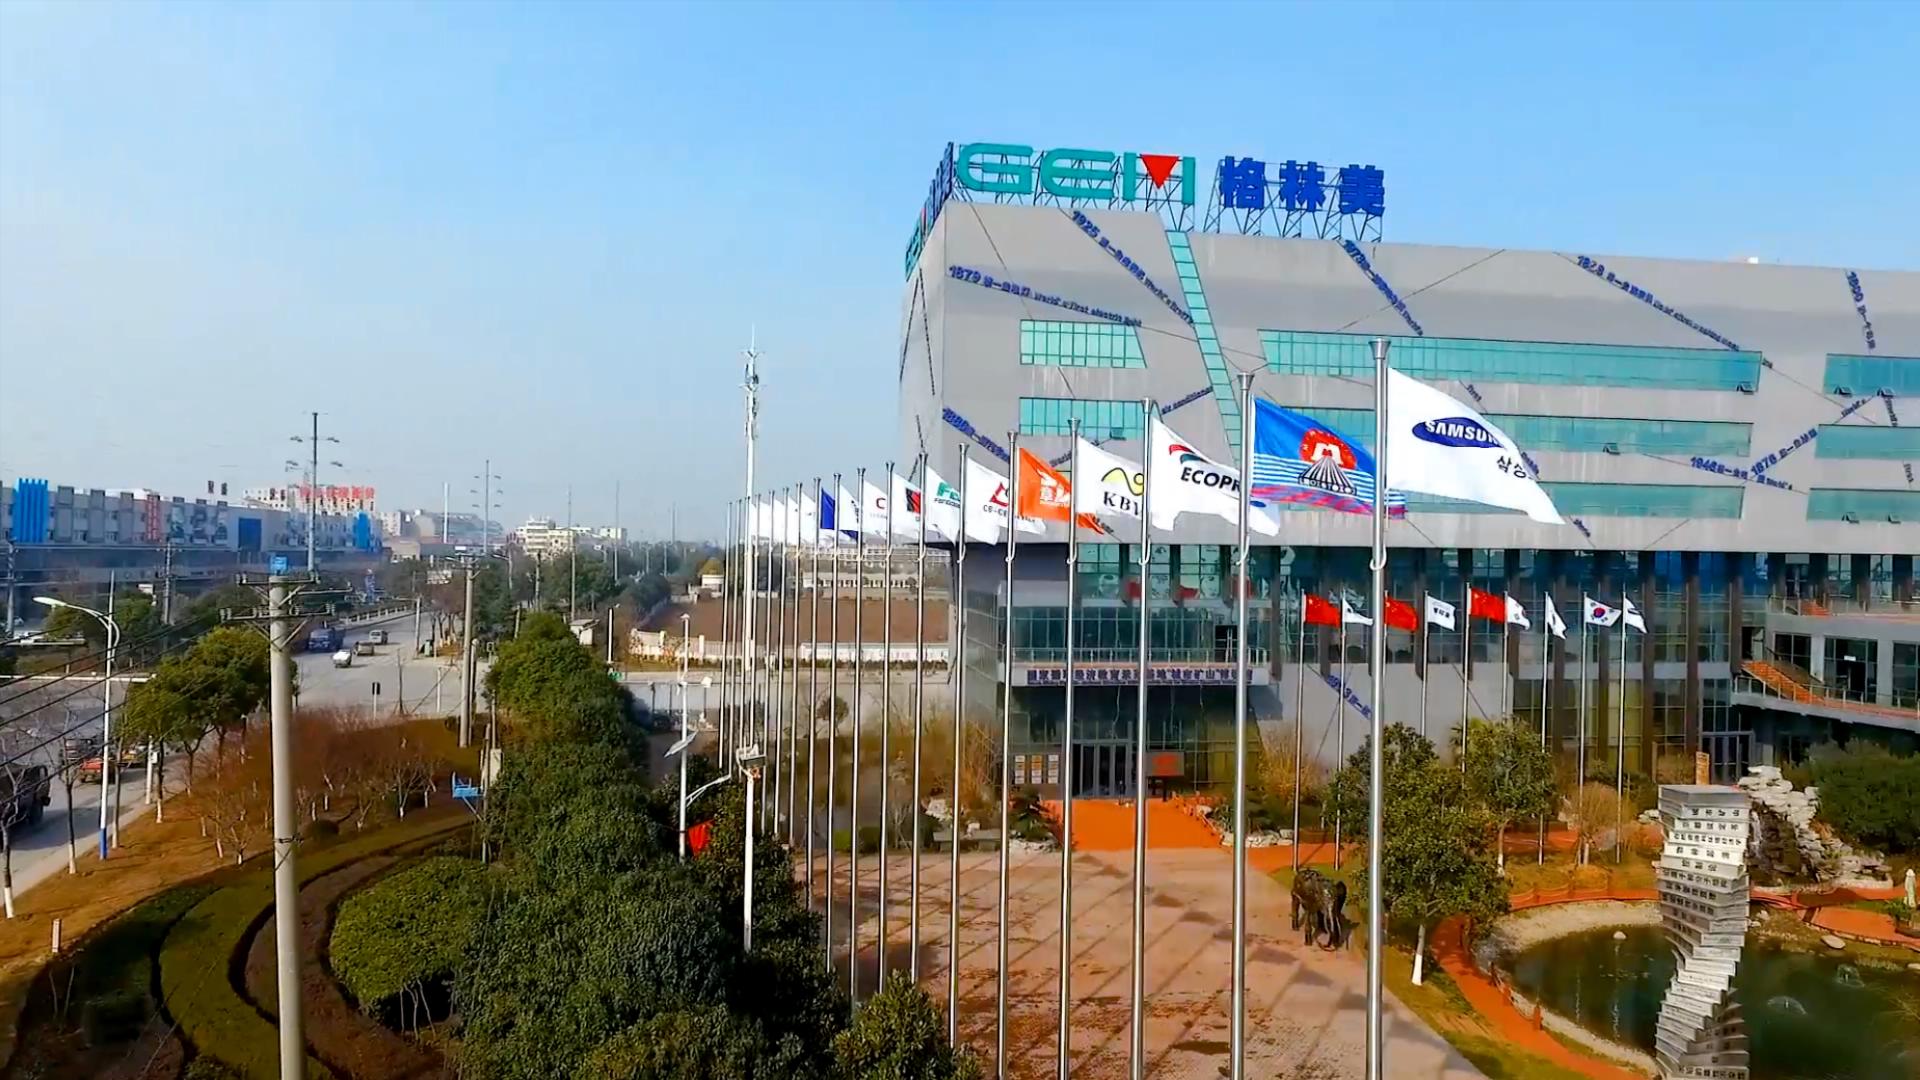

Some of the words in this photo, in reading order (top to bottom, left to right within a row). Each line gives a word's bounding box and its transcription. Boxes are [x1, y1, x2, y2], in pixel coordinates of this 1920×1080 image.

[1220, 156, 1385, 216] 格林美
[949, 265, 982, 284] 1879
[1425, 420, 1500, 446] SAMSUN
[1180, 466, 1240, 493] ECOPR
